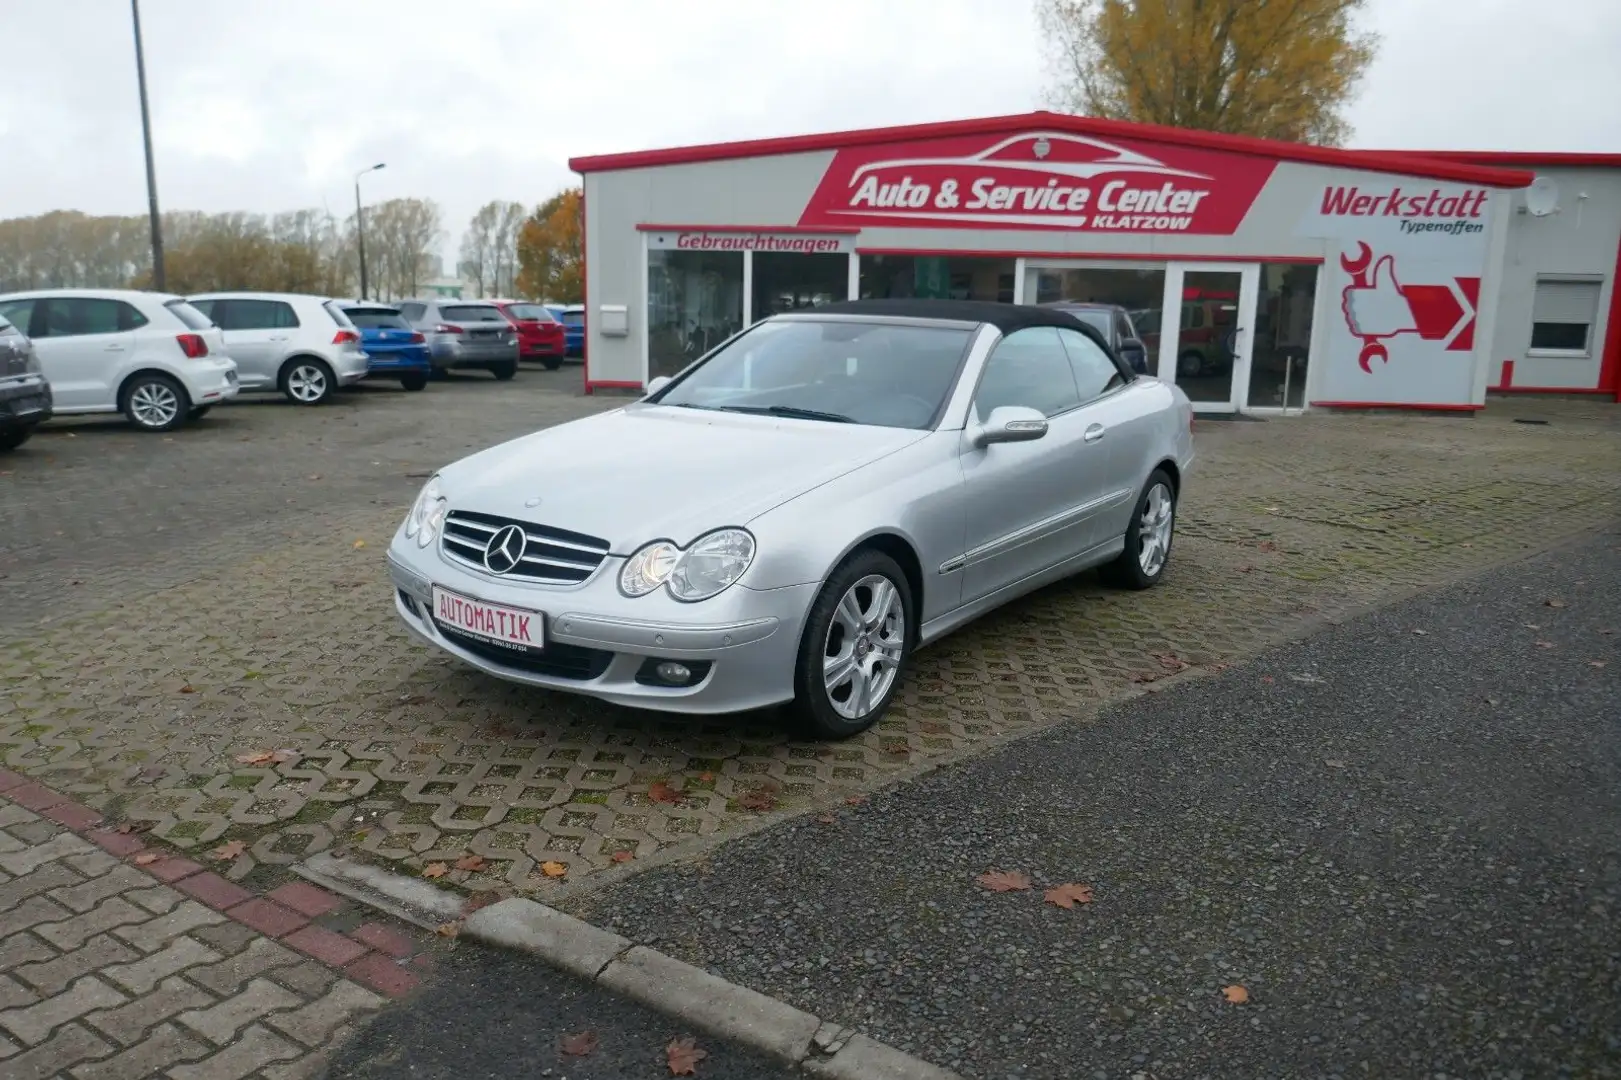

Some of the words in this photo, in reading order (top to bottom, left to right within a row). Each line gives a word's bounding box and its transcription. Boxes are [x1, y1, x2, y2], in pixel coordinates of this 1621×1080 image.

[849, 175, 931, 208] Auto
[934, 178, 960, 209] &
[965, 177, 1091, 211] Service
[1097, 180, 1210, 213] Center
[1320, 186, 1488, 218] Werkstatt
[1091, 215, 1193, 230] KLATZOW
[1399, 219, 1484, 235] Typenoffen
[677, 232, 839, 255] Gebrauchtwagen
[440, 594, 531, 641] AUTOMATIK
